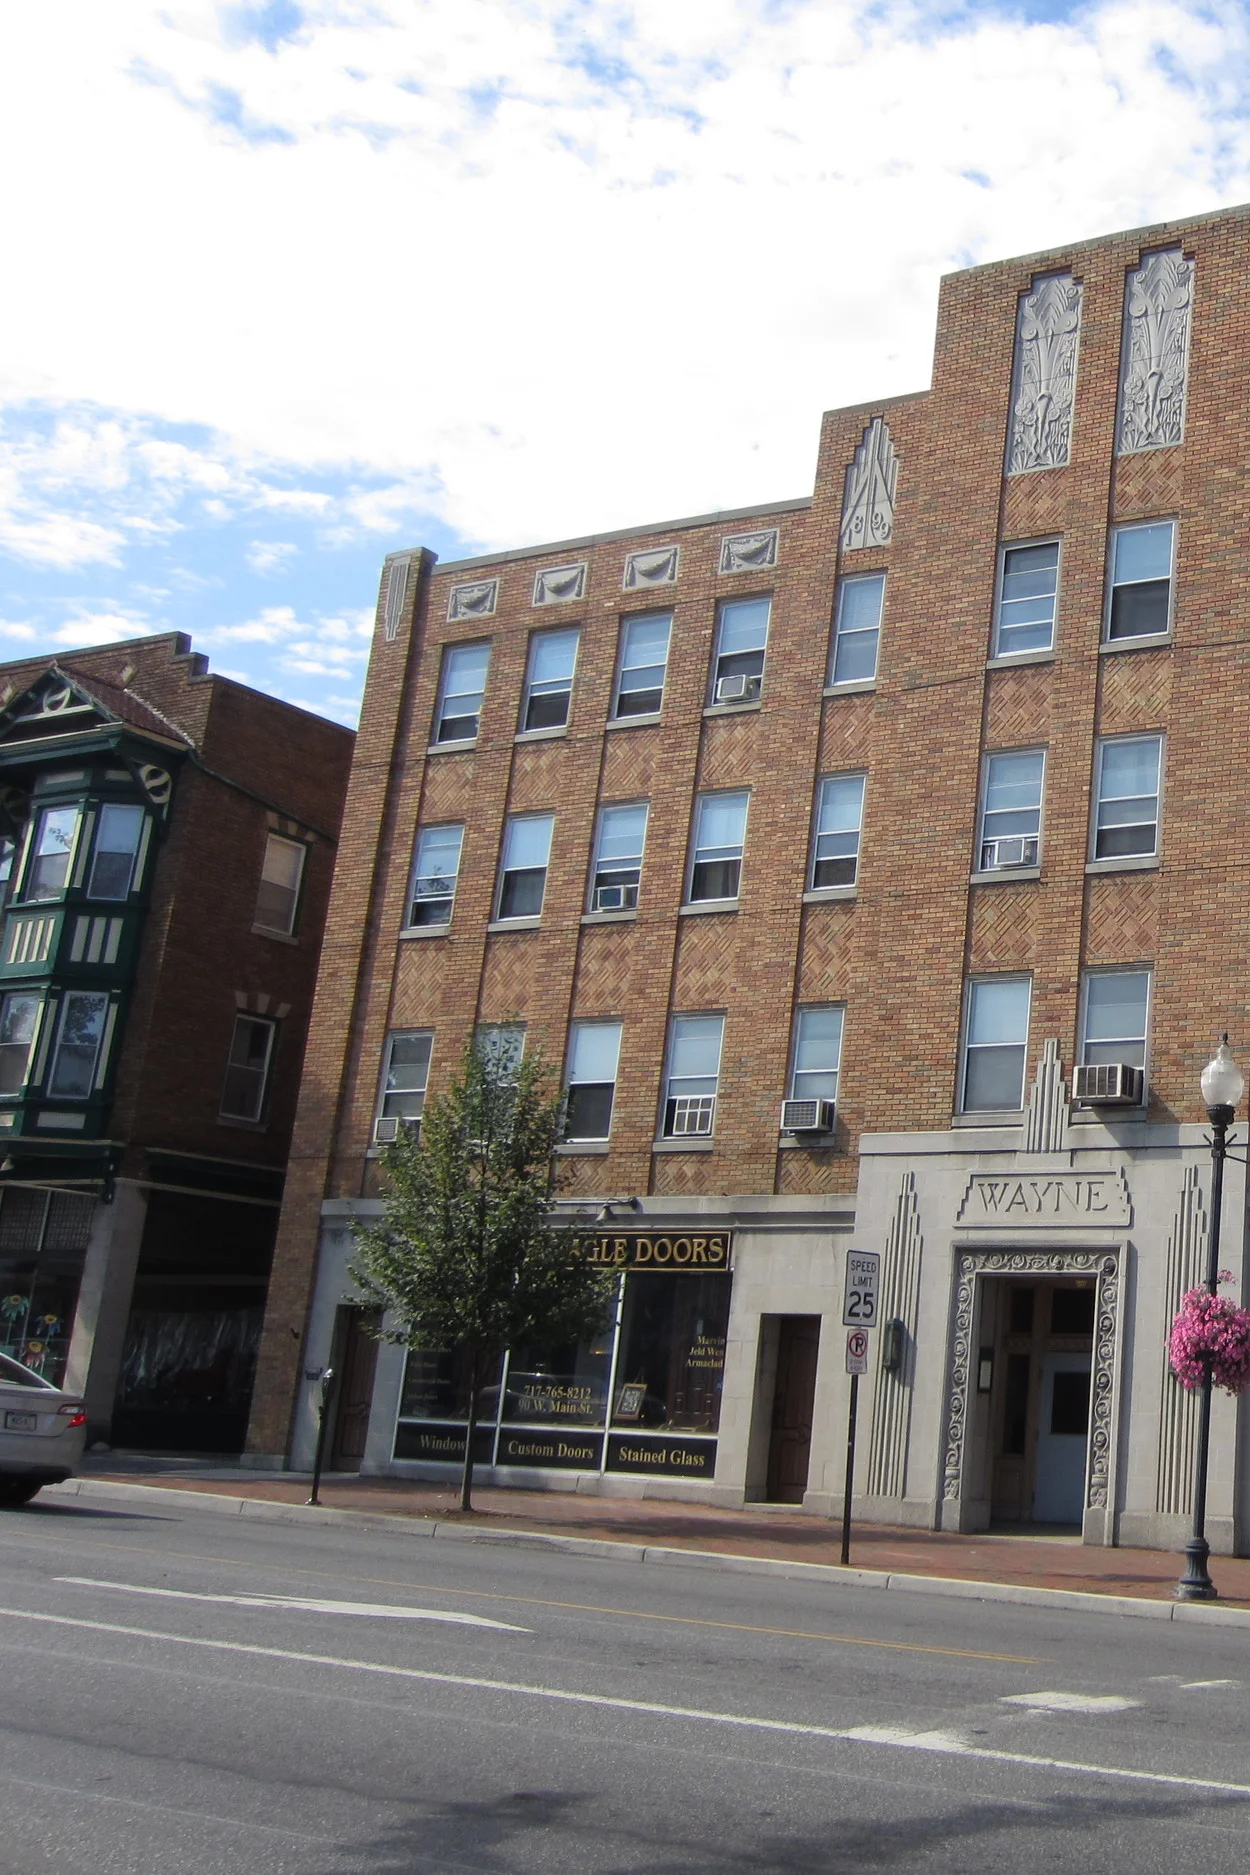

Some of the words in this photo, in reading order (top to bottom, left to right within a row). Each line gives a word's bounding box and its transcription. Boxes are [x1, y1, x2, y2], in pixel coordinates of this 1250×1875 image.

[977, 1181, 1109, 1213] WAYNE
[634, 1238, 724, 1263] DOORS
[850, 1259, 877, 1273] SPEED
[852, 1276, 873, 1288] LIMIT
[847, 1290, 874, 1319] 25
[689, 1346, 706, 1356] Jeld
[685, 1358, 724, 1368] Armaclad
[523, 1384, 592, 1400] 717-765-8212
[518, 1399, 531, 1411] 90
[533, 1400, 547, 1412] W.
[550, 1401, 578, 1413] Main
[579, 1402, 593, 1414] St.
[508, 1440, 554, 1457] Custom
[557, 1443, 595, 1460] Doors
[619, 1446, 666, 1464] Stained
[669, 1449, 705, 1467] Glass
